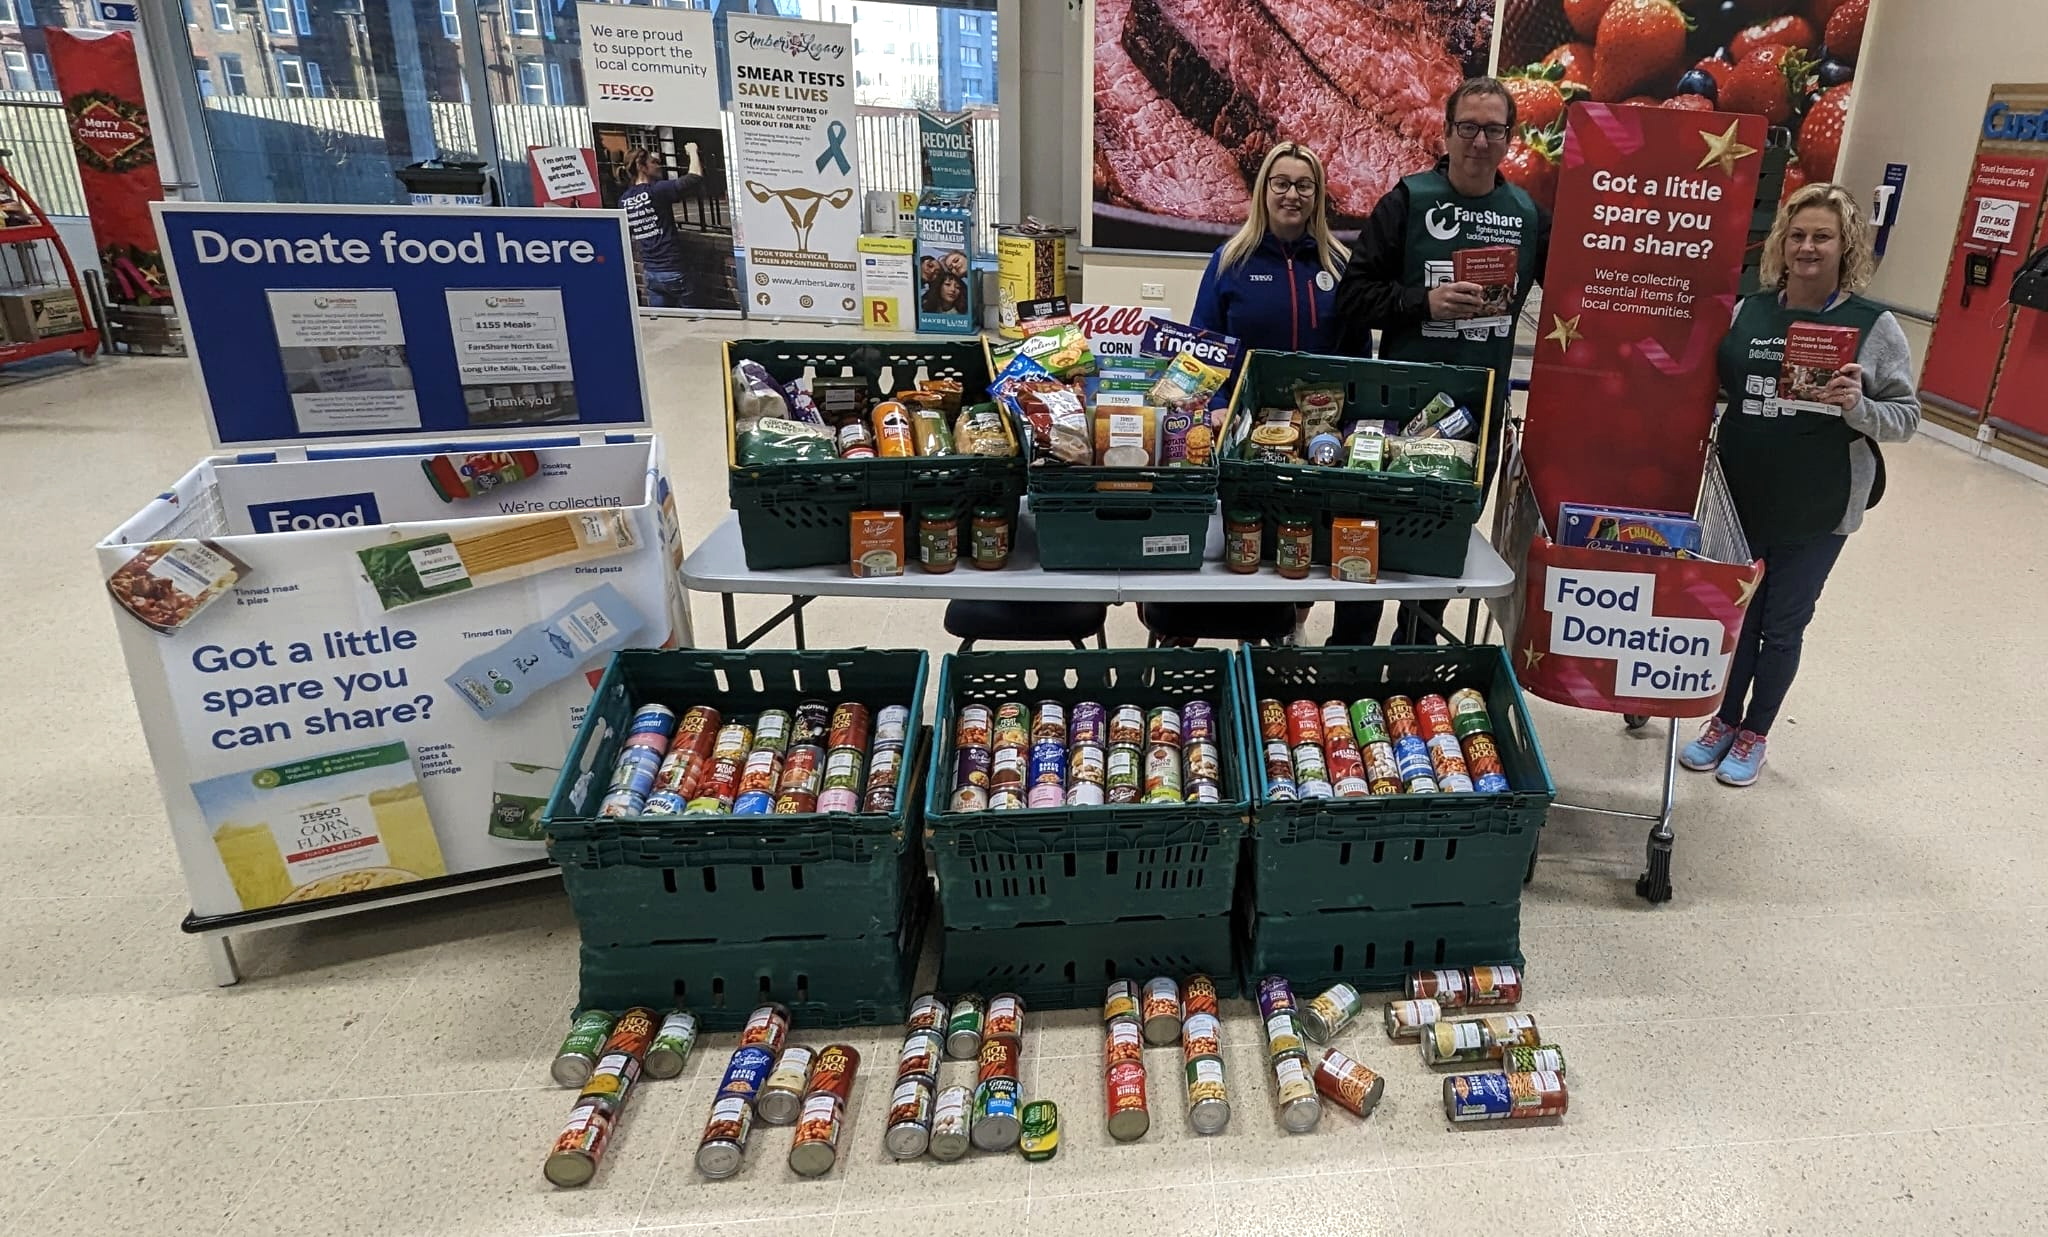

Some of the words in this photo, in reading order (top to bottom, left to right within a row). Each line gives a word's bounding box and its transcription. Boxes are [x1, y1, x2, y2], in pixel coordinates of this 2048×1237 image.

[590, 24, 613, 37] We
[616, 28, 639, 39] are
[642, 30, 683, 42] proud
[593, 42, 608, 53] to
[612, 45, 667, 58] support
[670, 46, 693, 58] the
[799, 32, 846, 61] Legacy
[595, 57, 627, 70] local
[631, 61, 707, 78] community
[737, 65, 795, 84] SMEAR
[799, 71, 846, 88] TESTS
[598, 83, 654, 97] TESCO
[738, 83, 781, 99] SAVE
[785, 87, 830, 103] LIVES
[739, 102, 754, 111] THE
[755, 103, 776, 112] MAIN
[777, 105, 818, 116] SYMPTOMS
[740, 111, 775, 121] CERVICAL
[776, 113, 806, 122] CANCER
[85, 118, 120, 131] Merry
[741, 120, 761, 128] LOOK
[763, 121, 778, 129] OUT
[780, 122, 795, 130] FOR
[78, 128, 136, 140] Christmas
[921, 131, 972, 150] RECYCLE
[543, 157, 555, 165] I'm
[556, 156, 565, 164] on
[1996, 165, 2029, 177] Information
[1592, 170, 1638, 194] Got
[1643, 179, 1658, 196] a
[1665, 176, 1722, 202] little
[1977, 175, 2006, 187] Freephone
[2006, 176, 2018, 187] Car
[2017, 177, 2030, 189] Hire
[621, 192, 649, 207] TESCO
[903, 194, 914, 208] R
[1454, 207, 1524, 228] FareShare
[1592, 203, 1661, 226] spare
[1667, 211, 1711, 232] you
[1980, 215, 1994, 224] CITY
[922, 219, 965, 234] RECYCLE
[1975, 226, 2010, 238] FREEPHONE
[1490, 233, 1505, 243] food
[192, 230, 371, 264] Donate
[380, 231, 486, 264] food
[497, 232, 606, 264] here.
[1582, 232, 1626, 251] can
[1633, 234, 1714, 260] share?
[754, 249, 773, 258] BOOK
[773, 250, 794, 259] YOUR
[794, 252, 827, 261] CERVICAL
[753, 257, 780, 266] SCREEN
[780, 258, 829, 269] APPOINTMENT
[771, 277, 856, 291] www.AmbersLaw.org
[1595, 268, 1629, 282] We're
[1632, 272, 1690, 291] collecting
[1584, 284, 1638, 299] essential
[1640, 288, 1674, 302] items
[1677, 291, 1695, 304] for
[872, 300, 891, 323] R
[1581, 297, 1609, 310] local
[1612, 300, 1693, 319] communities.
[475, 321, 502, 329] 1155
[503, 320, 532, 329] Meals
[1750, 337, 1773, 346] Food
[1792, 334, 1817, 344] Donate
[1816, 334, 1833, 344] food
[468, 344, 510, 352] FareShare
[511, 343, 536, 351] North
[536, 342, 554, 351] East
[1100, 341, 1133, 356] CORN
[462, 366, 484, 375] Long
[484, 365, 499, 373] Life
[486, 397, 526, 408] Thank
[529, 396, 553, 408] you
[499, 499, 544, 514] We're
[548, 494, 622, 510] collecting
[268, 505, 368, 530] Food
[575, 566, 598, 576] Dried
[599, 566, 623, 578] pasta
[234, 586, 270, 597] Tinned
[271, 583, 300, 594] meat
[1557, 577, 1641, 612] Food
[236, 598, 246, 607] &
[246, 596, 269, 608] pies
[462, 630, 495, 640] Tinned
[495, 627, 513, 638] fish
[1562, 615, 1710, 656] Donation
[192, 640, 278, 674] Got
[288, 642, 314, 664] a
[323, 626, 418, 660] little
[1630, 661, 1722, 693] Point.
[202, 679, 324, 718] spare
[333, 667, 409, 702] you
[211, 720, 293, 750] can
[304, 694, 434, 736] share?
[419, 753, 439, 762] oats
[441, 752, 449, 760] &
[421, 759, 453, 770] instant
[423, 766, 462, 779] porridge
[300, 807, 342, 821] TESCO
[300, 817, 350, 837] CORN
[297, 827, 363, 850] FLAKES
[989, 1077, 1014, 1088] Green
